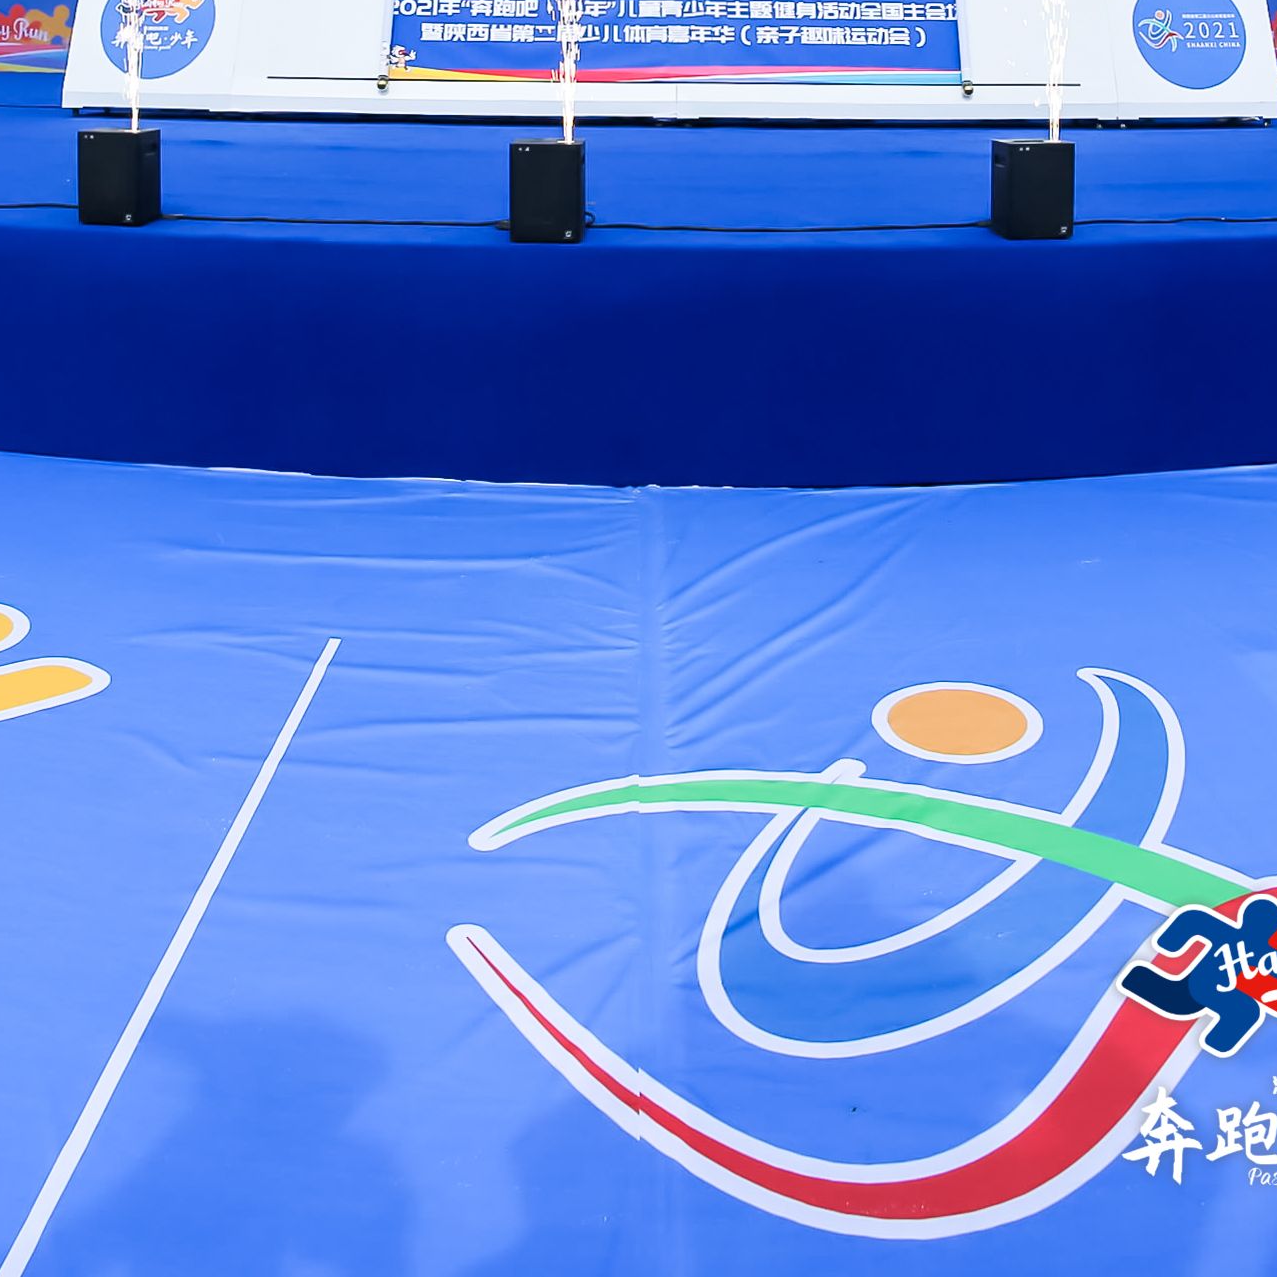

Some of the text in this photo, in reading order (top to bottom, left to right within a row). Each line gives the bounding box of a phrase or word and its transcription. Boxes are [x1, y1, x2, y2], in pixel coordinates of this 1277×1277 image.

[13, 17, 50, 42] Run
[1183, 21, 1240, 39] 2021
[1219, 41, 1241, 49] CHINA
